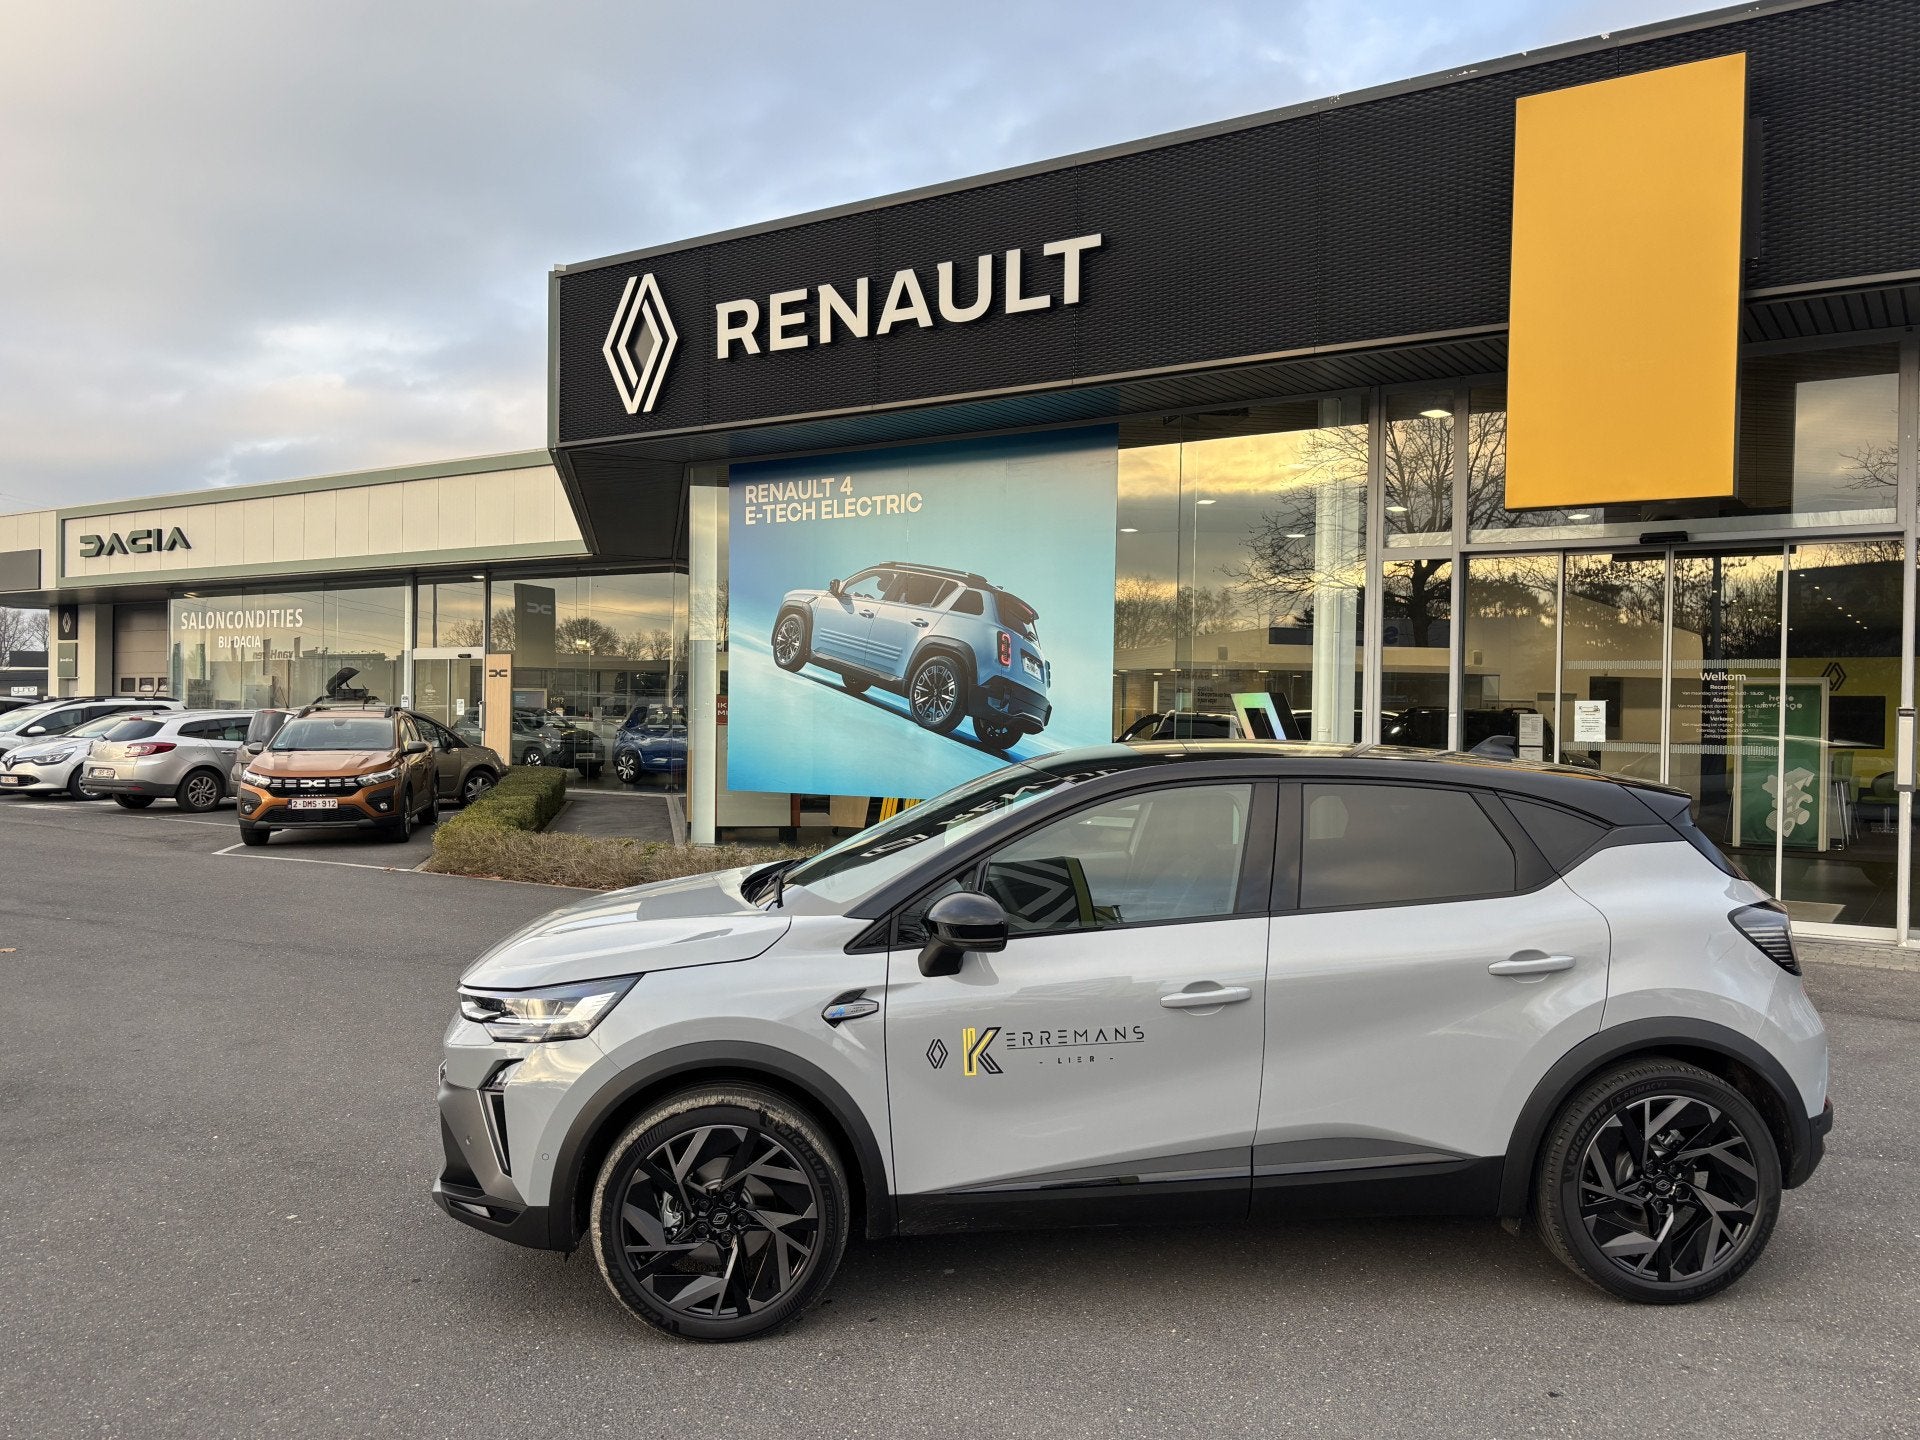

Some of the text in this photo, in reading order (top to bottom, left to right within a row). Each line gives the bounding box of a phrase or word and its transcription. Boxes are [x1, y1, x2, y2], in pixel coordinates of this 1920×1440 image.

[715, 233, 1102, 360] RENAULT
[745, 476, 853, 504] RENAULT 4
[745, 492, 923, 525] E-TECH ELECTRIC
[79, 526, 192, 558] DACIA
[181, 608, 304, 630] SALONCONDITIES
[218, 635, 261, 649] BIJ DACIA
[1700, 672, 1747, 681] Welkom
[293, 800, 337, 808] 2-DMS-912
[1058, 1055, 1095, 1064] LIER
[778, 1124, 828, 1179] MICHELIN
